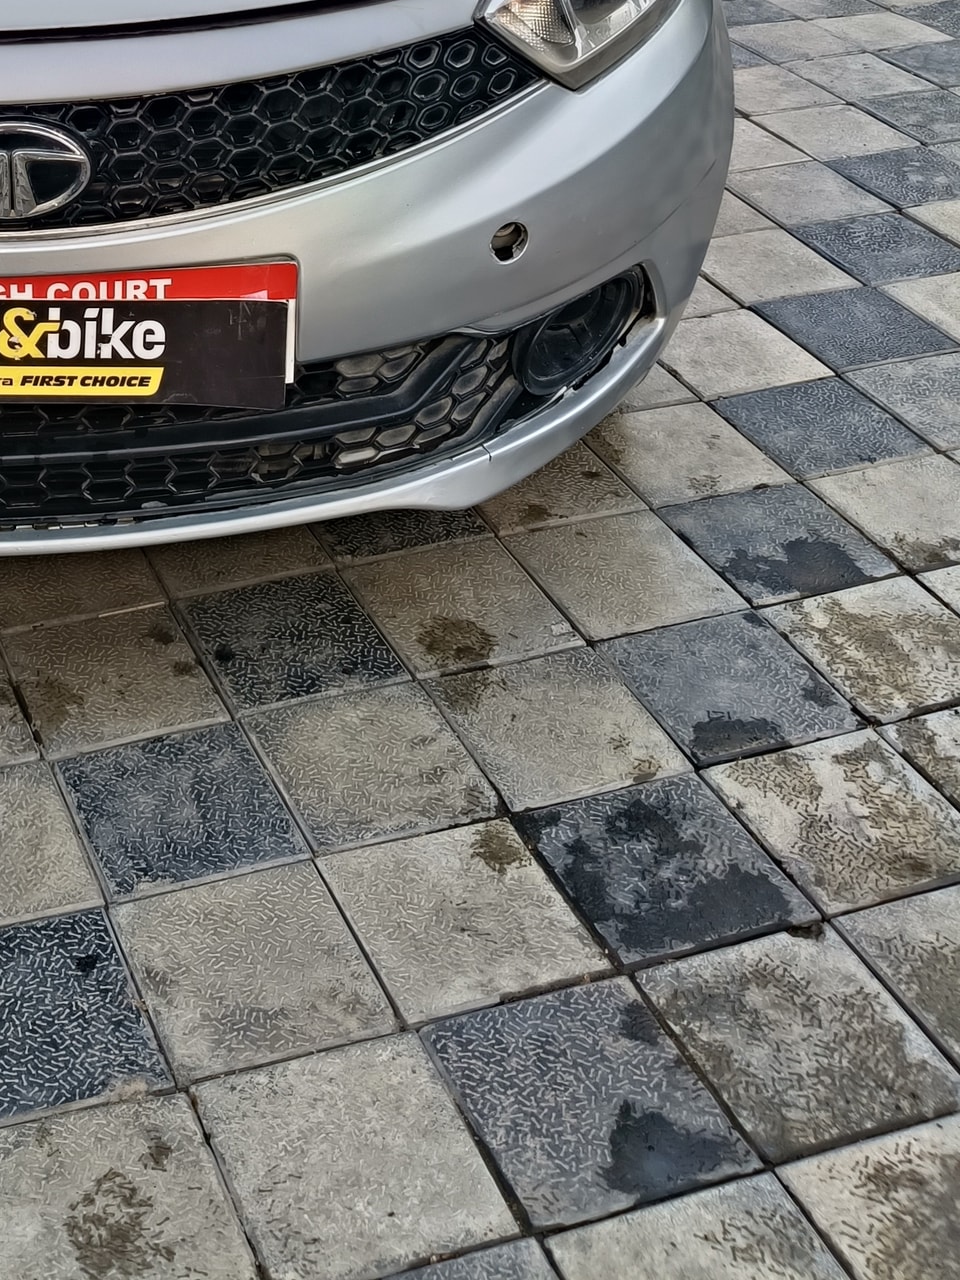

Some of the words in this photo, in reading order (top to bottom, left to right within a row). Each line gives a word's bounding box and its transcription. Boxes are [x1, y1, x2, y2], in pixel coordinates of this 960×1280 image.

[47, 278, 172, 301] COURT
[20, 375, 78, 388] FIRST
[79, 376, 152, 388] CHOICE
